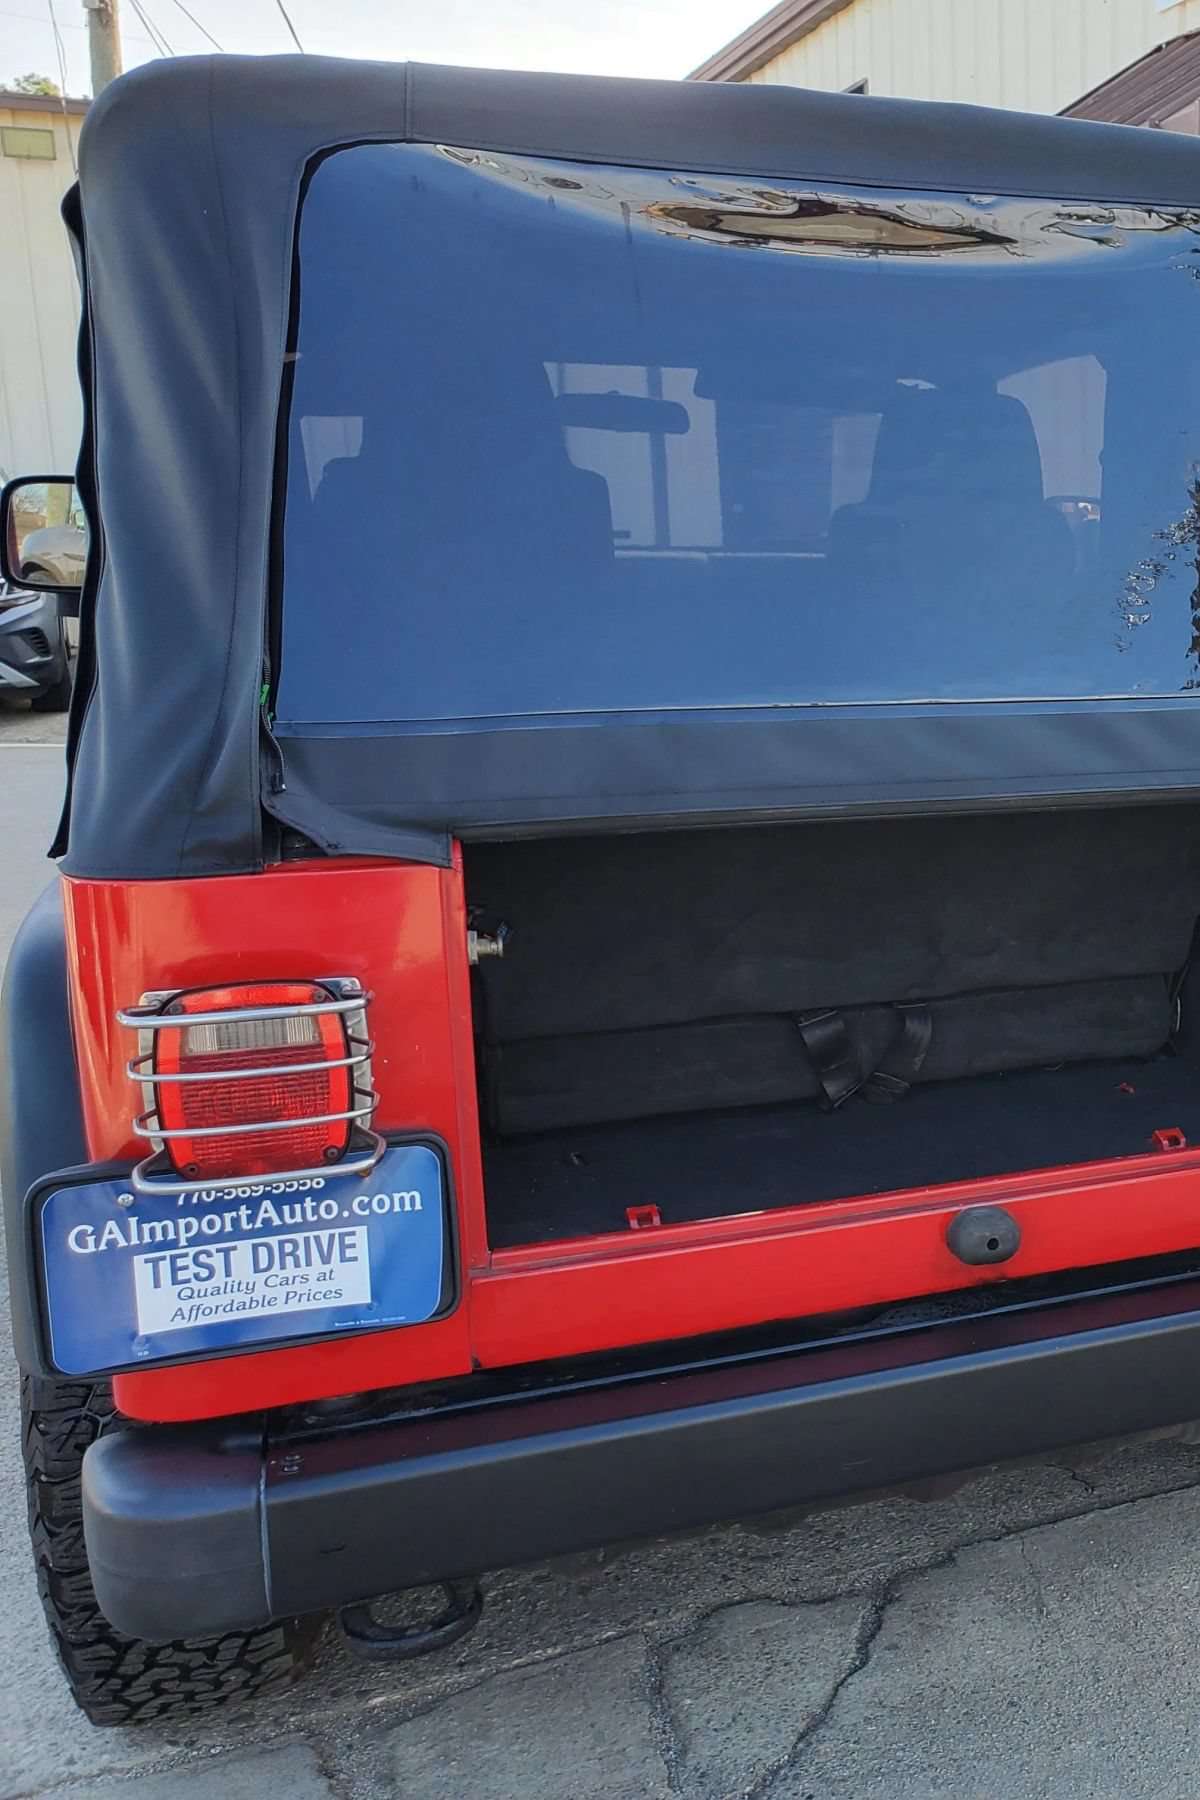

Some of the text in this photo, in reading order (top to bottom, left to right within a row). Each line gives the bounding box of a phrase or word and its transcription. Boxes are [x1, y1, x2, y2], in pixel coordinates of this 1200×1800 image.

[68, 1190, 423, 1254] GAImportAuto.com
[144, 1230, 359, 1289] TEST DRIVE
[169, 1287, 343, 1323] Affordable Prices
[177, 1268, 336, 1301] Quality Cars at
